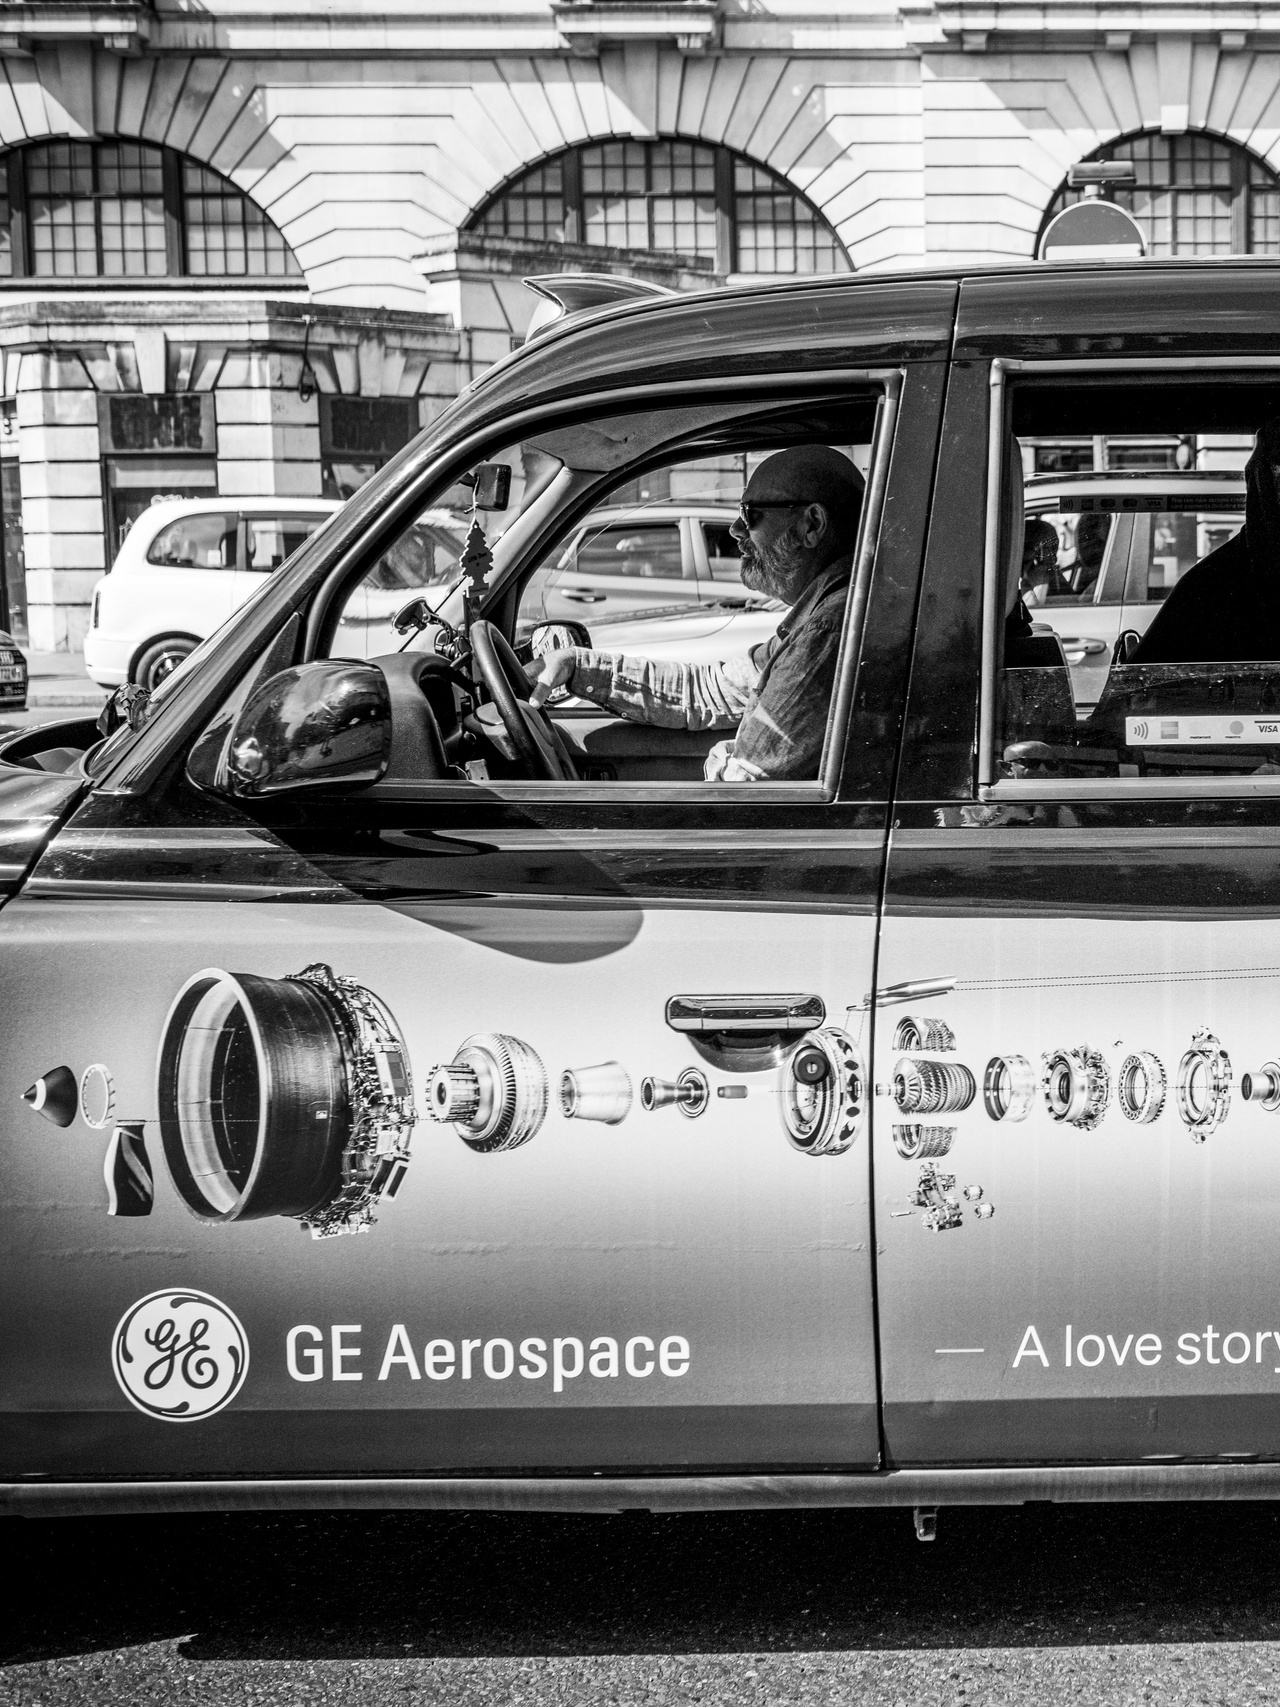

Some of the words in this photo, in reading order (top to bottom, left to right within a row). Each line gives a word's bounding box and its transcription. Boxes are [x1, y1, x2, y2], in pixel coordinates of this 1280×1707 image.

[1258, 725, 1279, 733] VISA
[285, 1324, 363, 1382] GE
[377, 1324, 691, 1393] Aerospace
[1011, 1324, 1050, 1368] A
[1064, 1324, 1163, 1367] love
